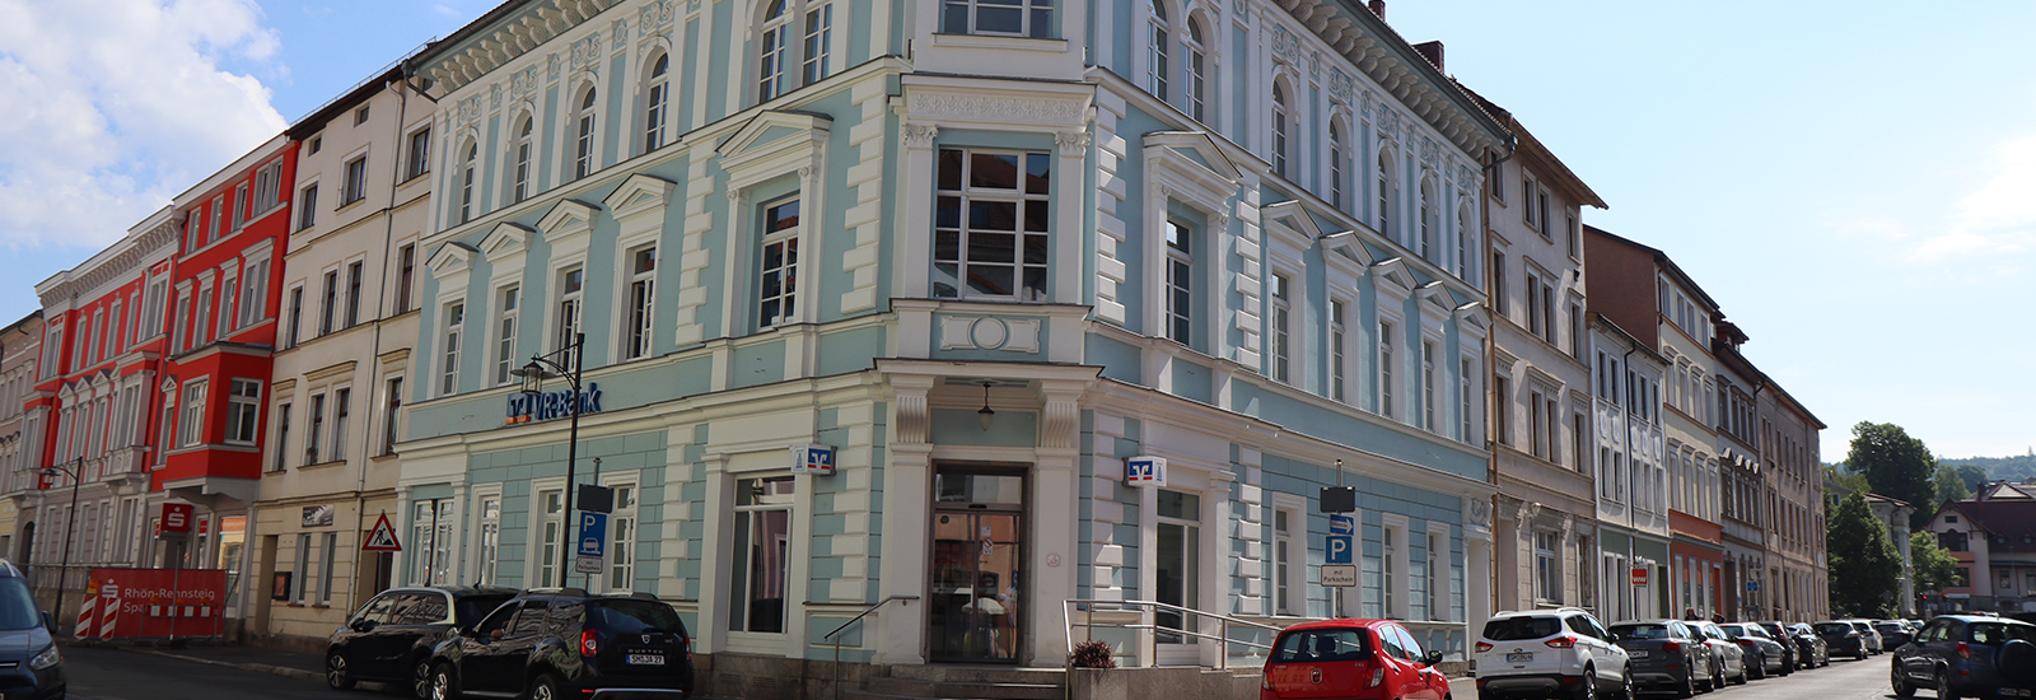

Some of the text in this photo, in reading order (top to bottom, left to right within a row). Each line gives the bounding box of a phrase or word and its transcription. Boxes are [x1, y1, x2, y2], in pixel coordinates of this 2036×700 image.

[583, 515, 596, 532] P
[1331, 539, 1346, 560] P
[124, 588, 215, 600] Rhön-Rennsteig
